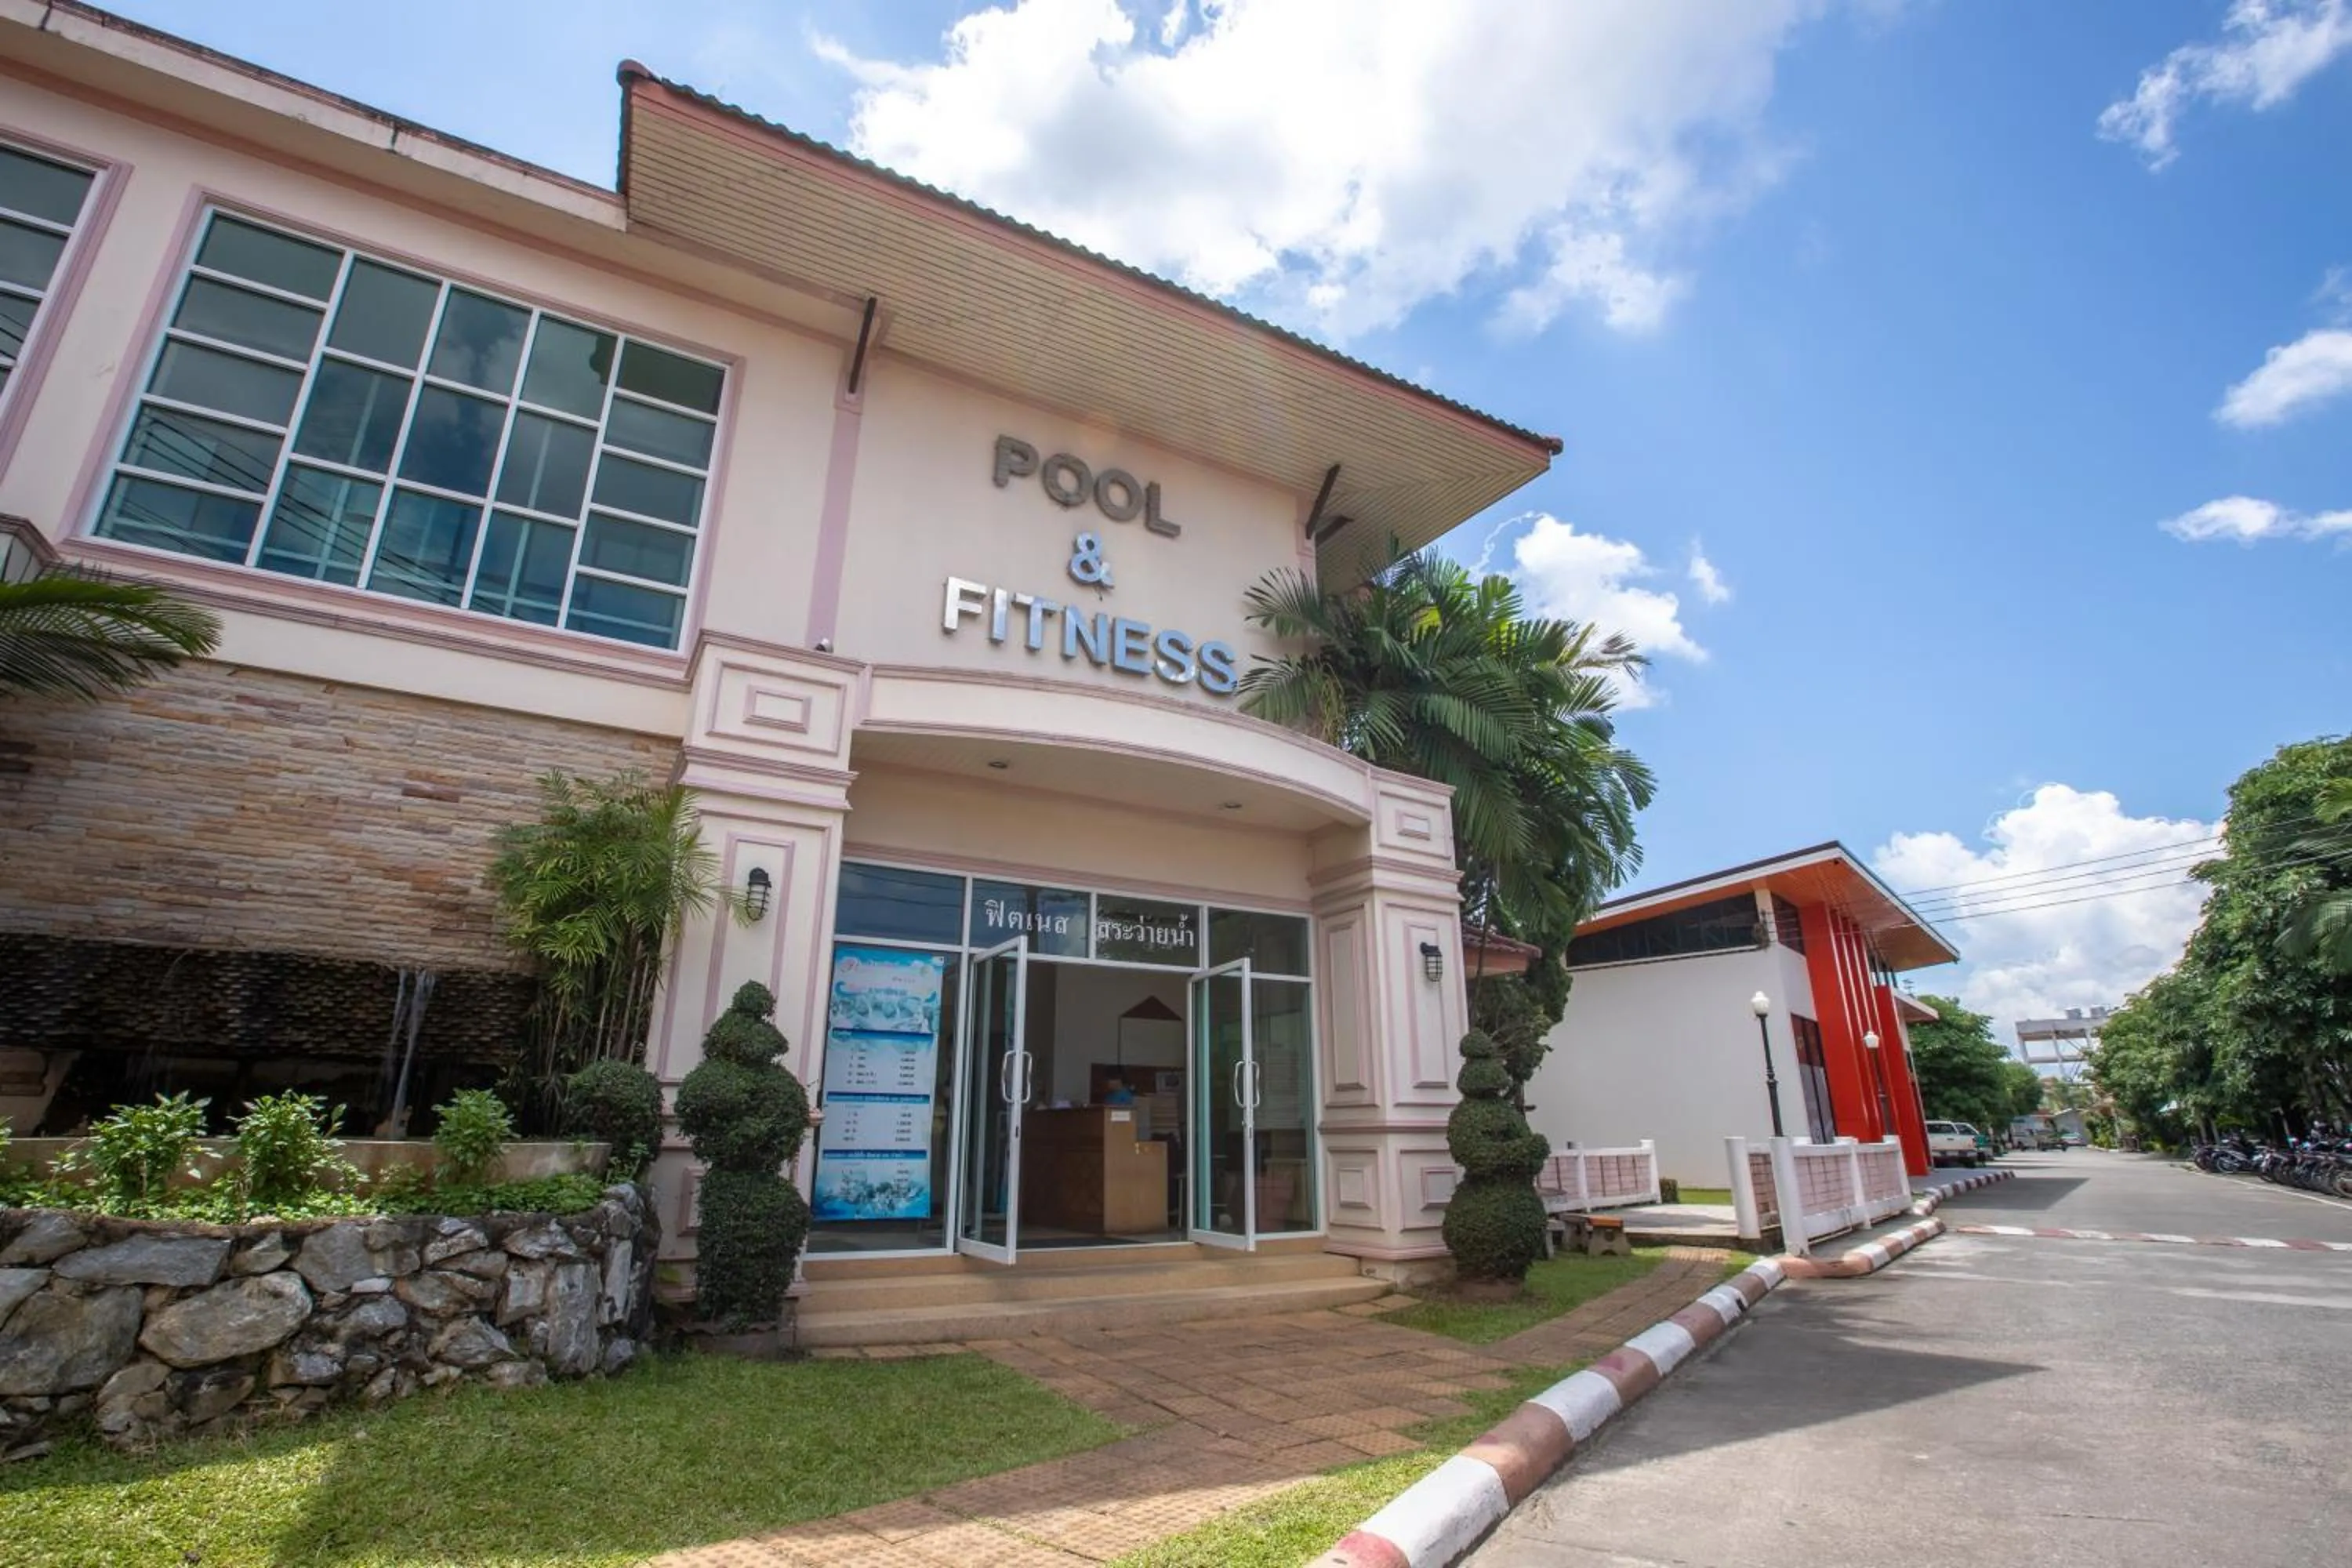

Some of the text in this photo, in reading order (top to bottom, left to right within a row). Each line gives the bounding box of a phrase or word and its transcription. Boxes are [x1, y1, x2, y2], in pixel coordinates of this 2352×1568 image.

[993, 434, 1181, 539] POOL
[1068, 531, 1115, 593] &
[942, 576, 1239, 696] FITNESS
